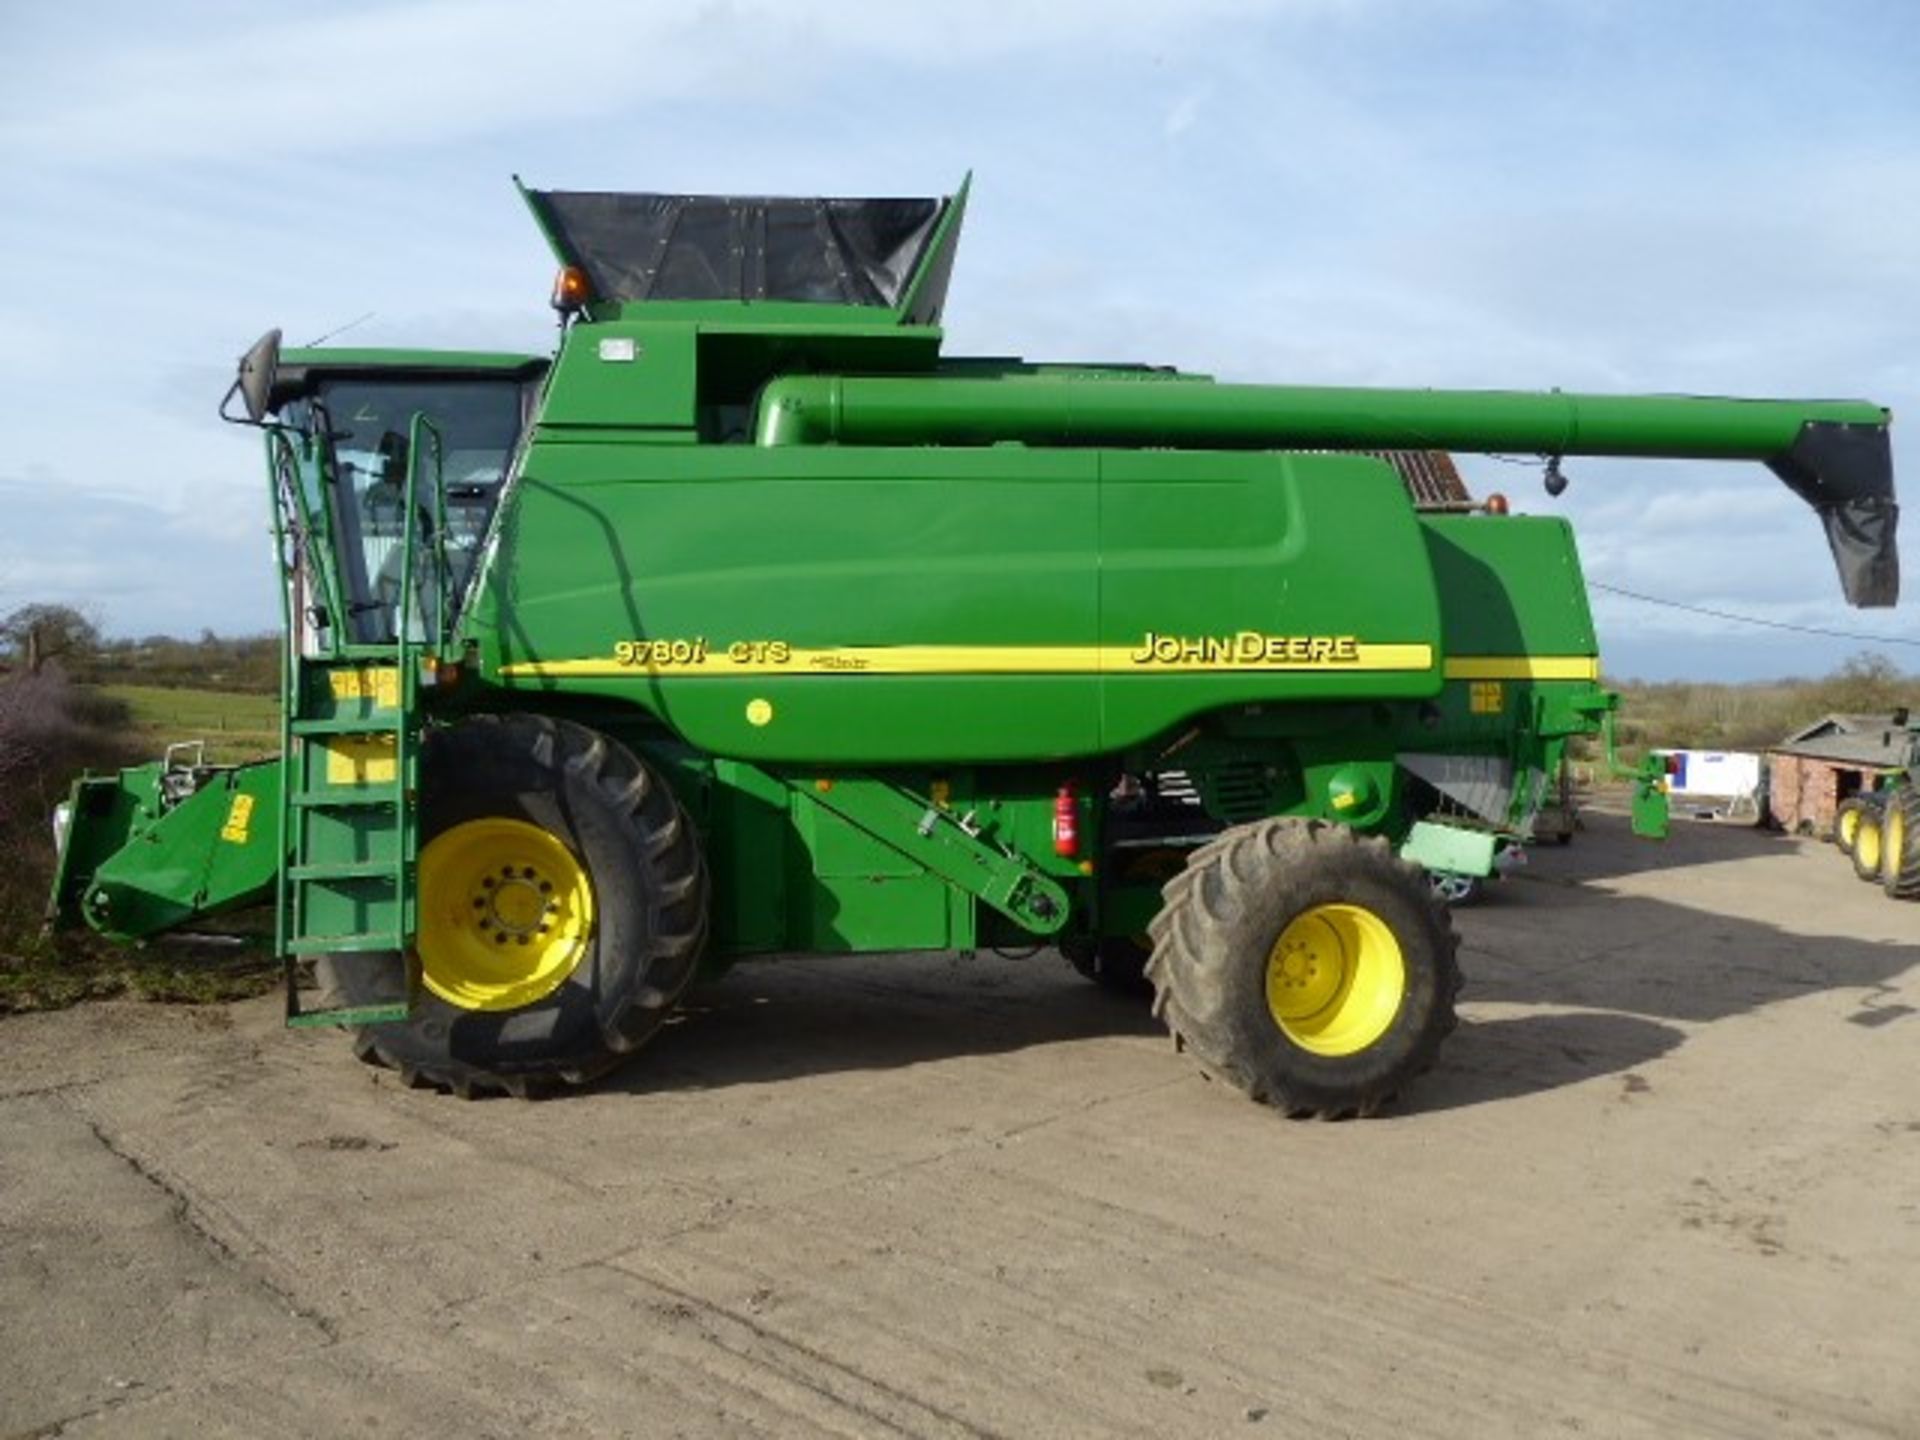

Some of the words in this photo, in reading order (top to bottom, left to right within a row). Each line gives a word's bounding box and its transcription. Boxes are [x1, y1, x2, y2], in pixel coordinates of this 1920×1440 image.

[614, 636, 707, 666] 9780i
[728, 640, 790, 664] CTS
[1132, 632, 1234, 662] JOHN
[1235, 631, 1359, 662] DEERE
